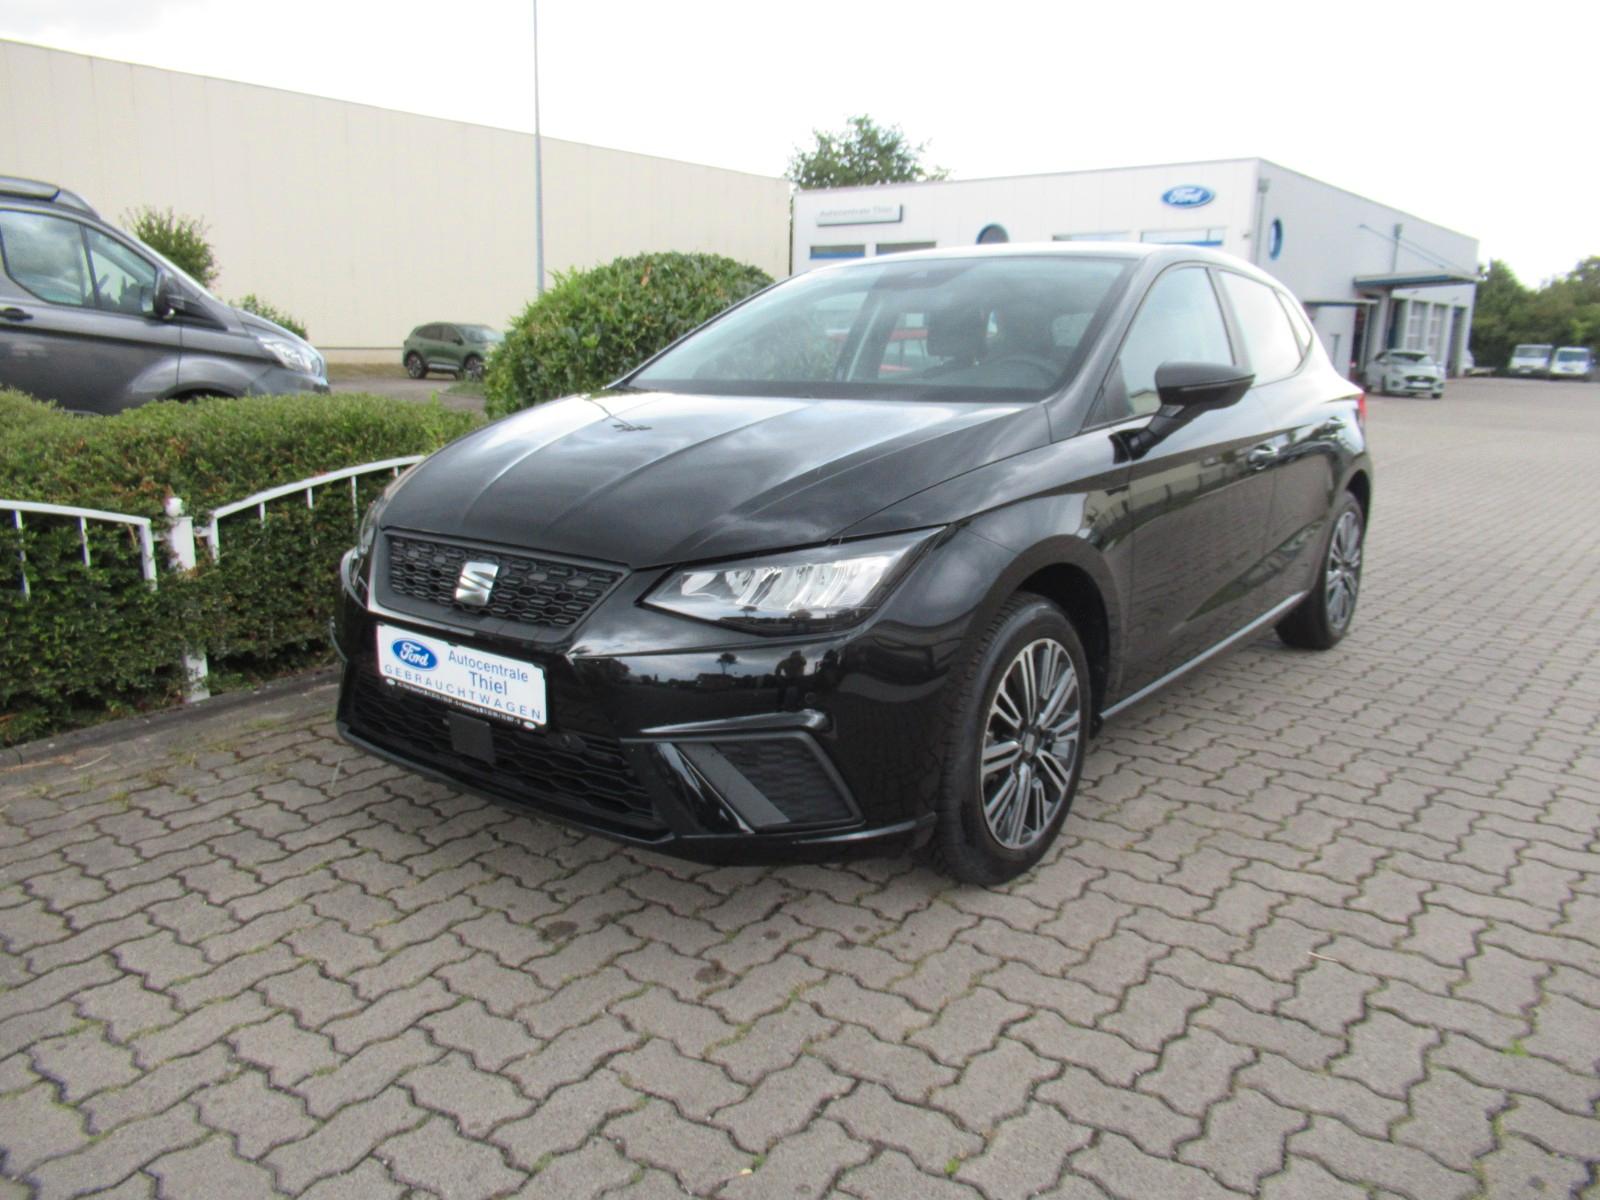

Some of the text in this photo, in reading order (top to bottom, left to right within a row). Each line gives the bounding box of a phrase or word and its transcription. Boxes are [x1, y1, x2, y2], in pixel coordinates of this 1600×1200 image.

[400, 641, 429, 666] Ford
[448, 650, 529, 682] Autocentrale
[384, 664, 541, 720] GEBRAUCHTWAGEN
[469, 671, 508, 696] Thiel
